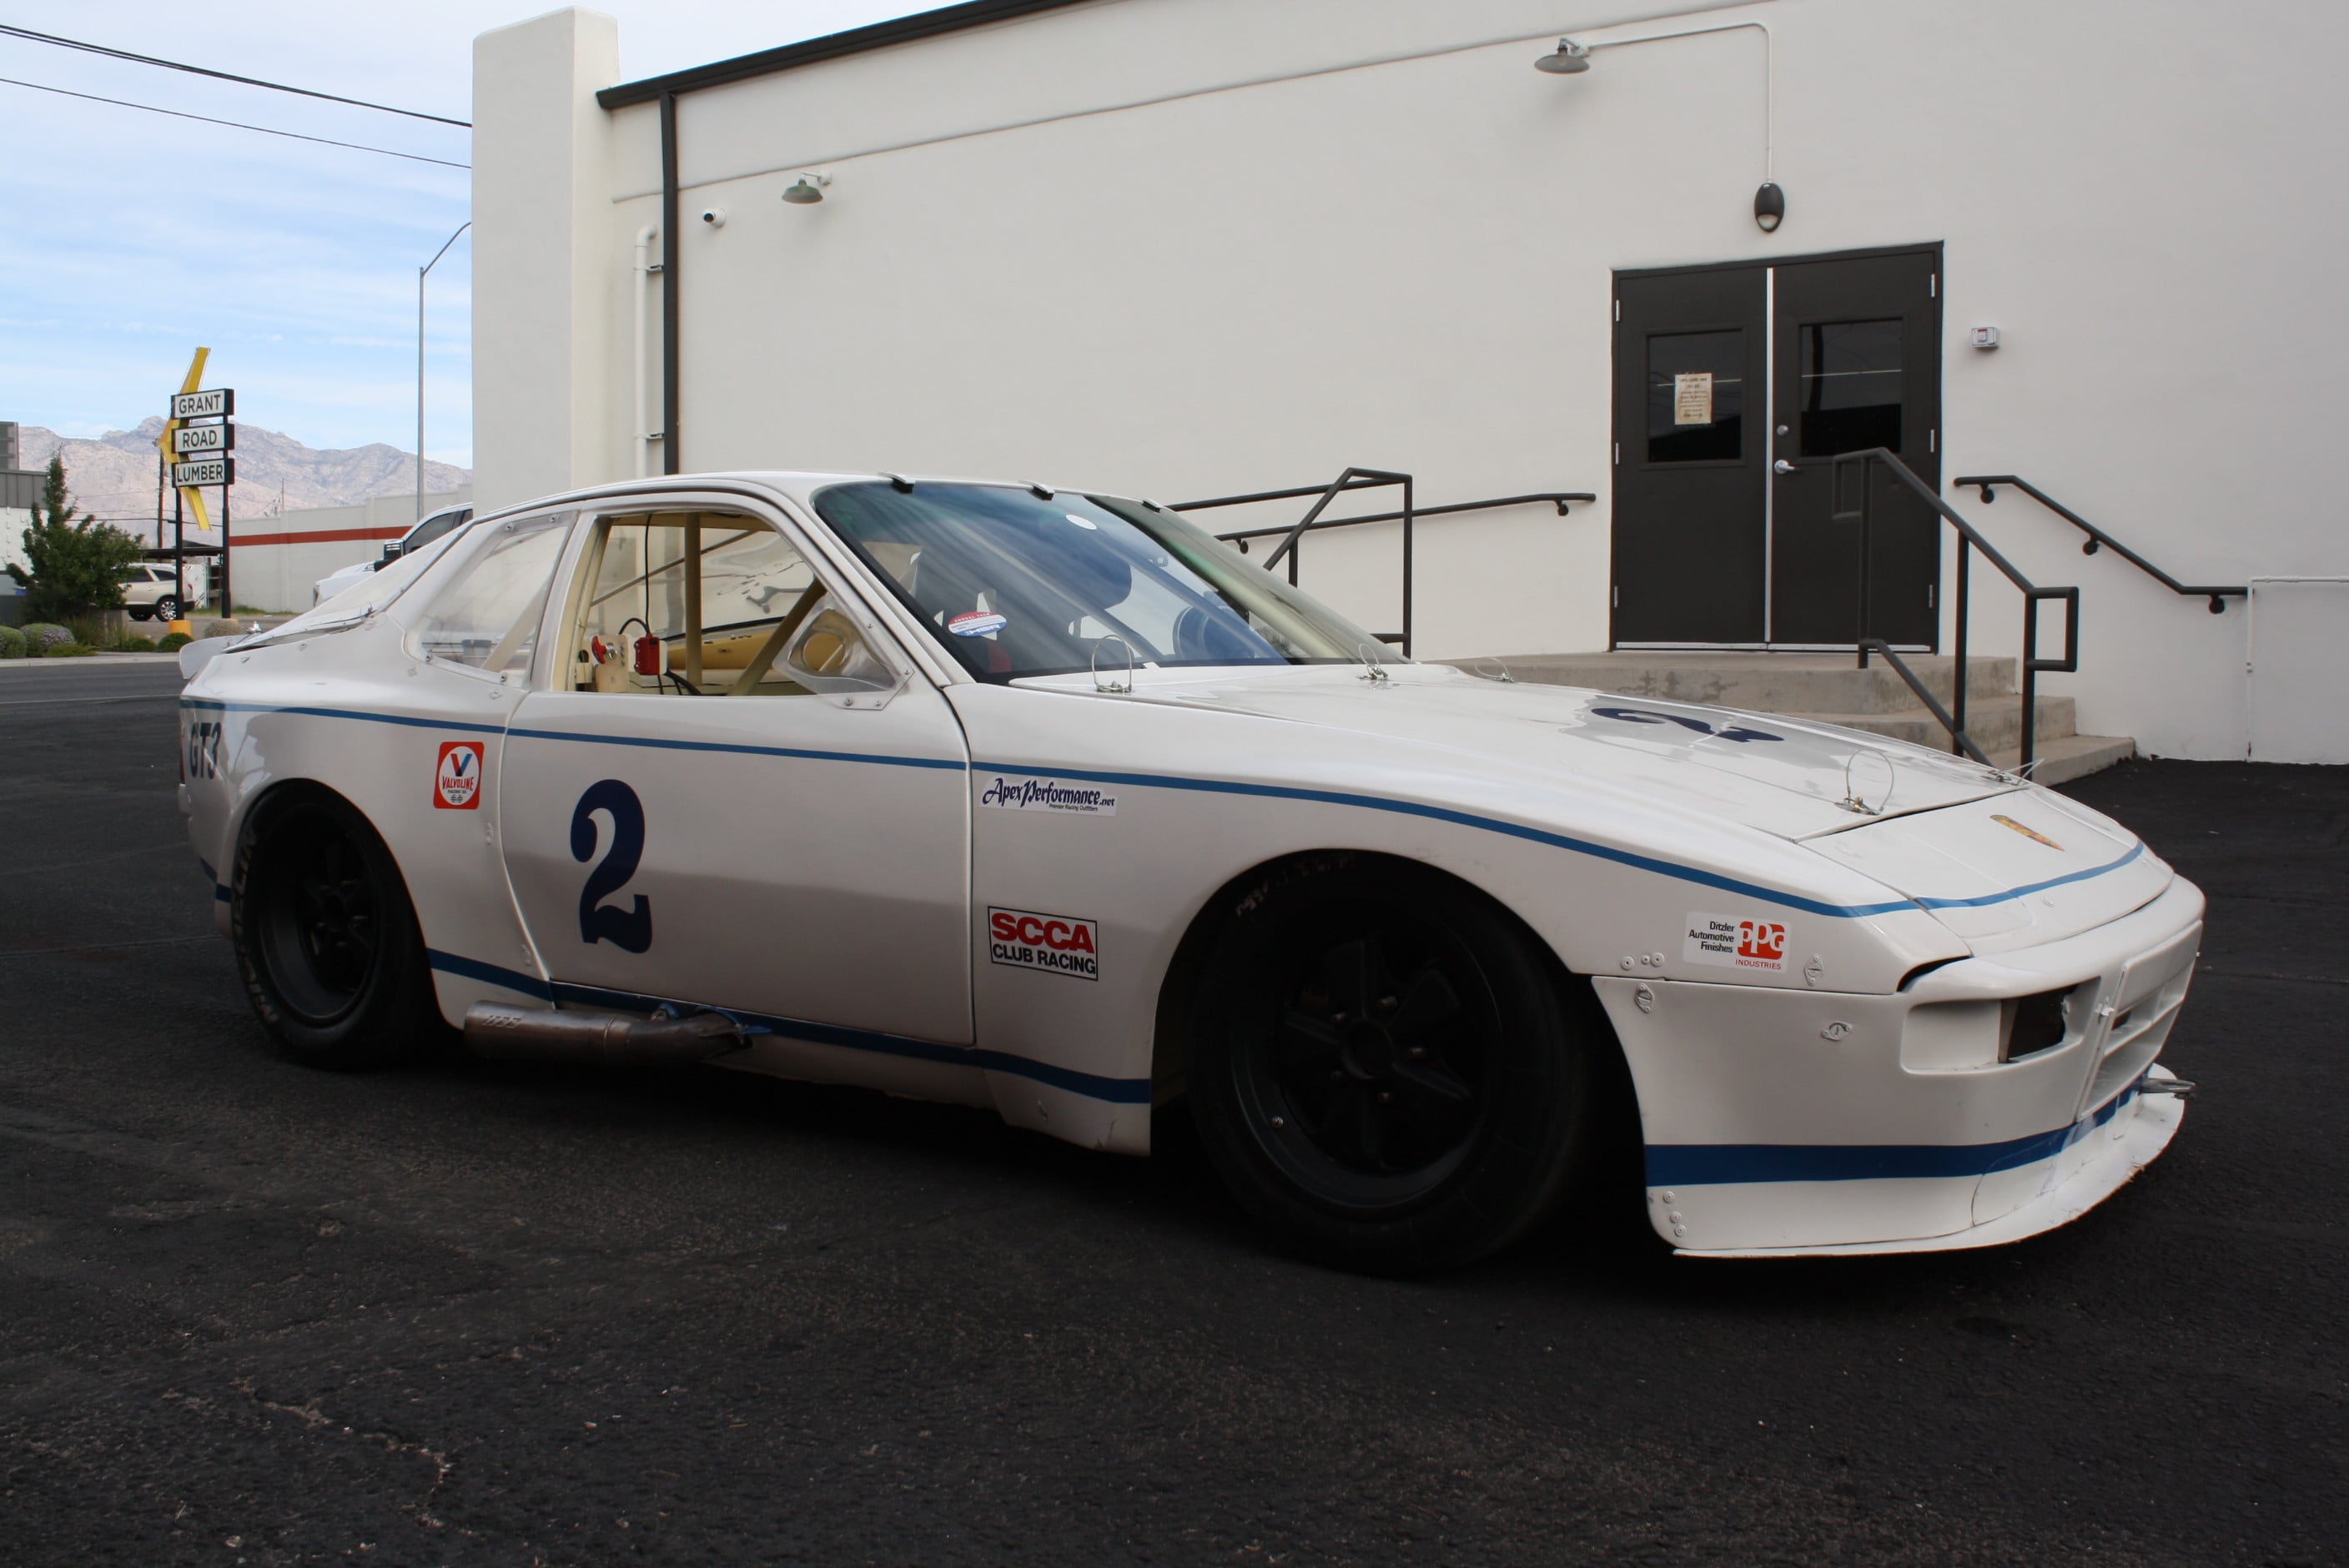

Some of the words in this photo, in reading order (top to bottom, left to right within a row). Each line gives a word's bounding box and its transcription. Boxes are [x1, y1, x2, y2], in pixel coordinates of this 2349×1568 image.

[179, 394, 221, 415] GRANT
[183, 430, 217, 448] ROAD
[177, 464, 224, 483] LUMBER
[190, 721, 222, 779] GT3
[442, 775, 475, 791] VALVOLINE
[571, 779, 652, 953] 2
[991, 912, 1094, 954] SCCA
[1688, 929, 1734, 942] Automotive
[1709, 921, 1735, 932] Ditzler
[1701, 941, 1733, 953] Finishes
[993, 943, 1034, 962] CLUB
[1037, 949, 1096, 974] RACING
[1735, 959, 1782, 970] INDUSTRIES
